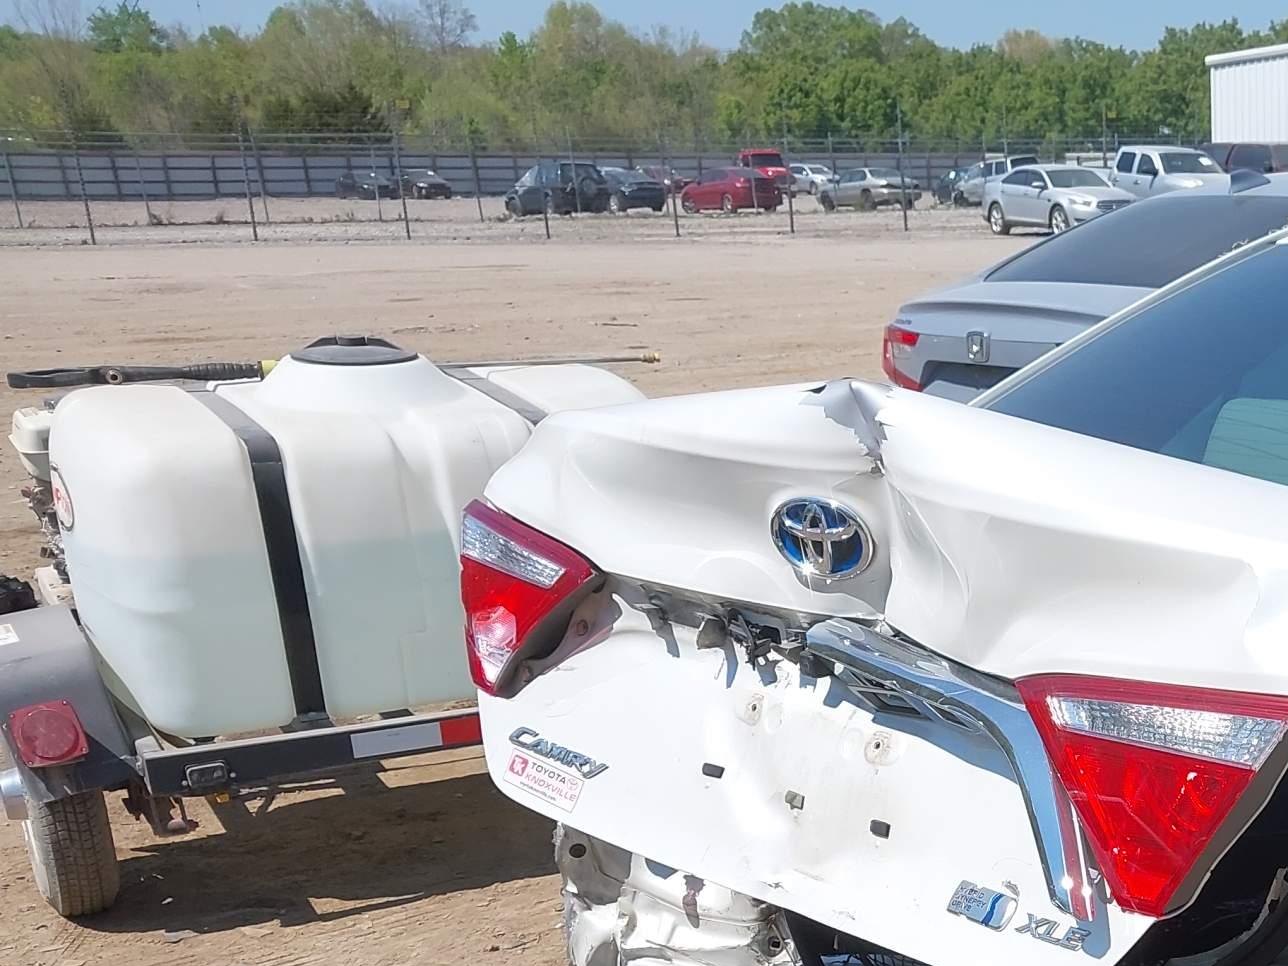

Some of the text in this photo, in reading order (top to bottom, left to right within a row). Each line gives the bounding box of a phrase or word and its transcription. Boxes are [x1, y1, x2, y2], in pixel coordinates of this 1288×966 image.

[508, 726, 609, 780] CAMRY
[525, 773, 577, 802] KNOXVILLE
[531, 762, 567, 785] TOYOTA
[1014, 912, 1092, 952] XLE
